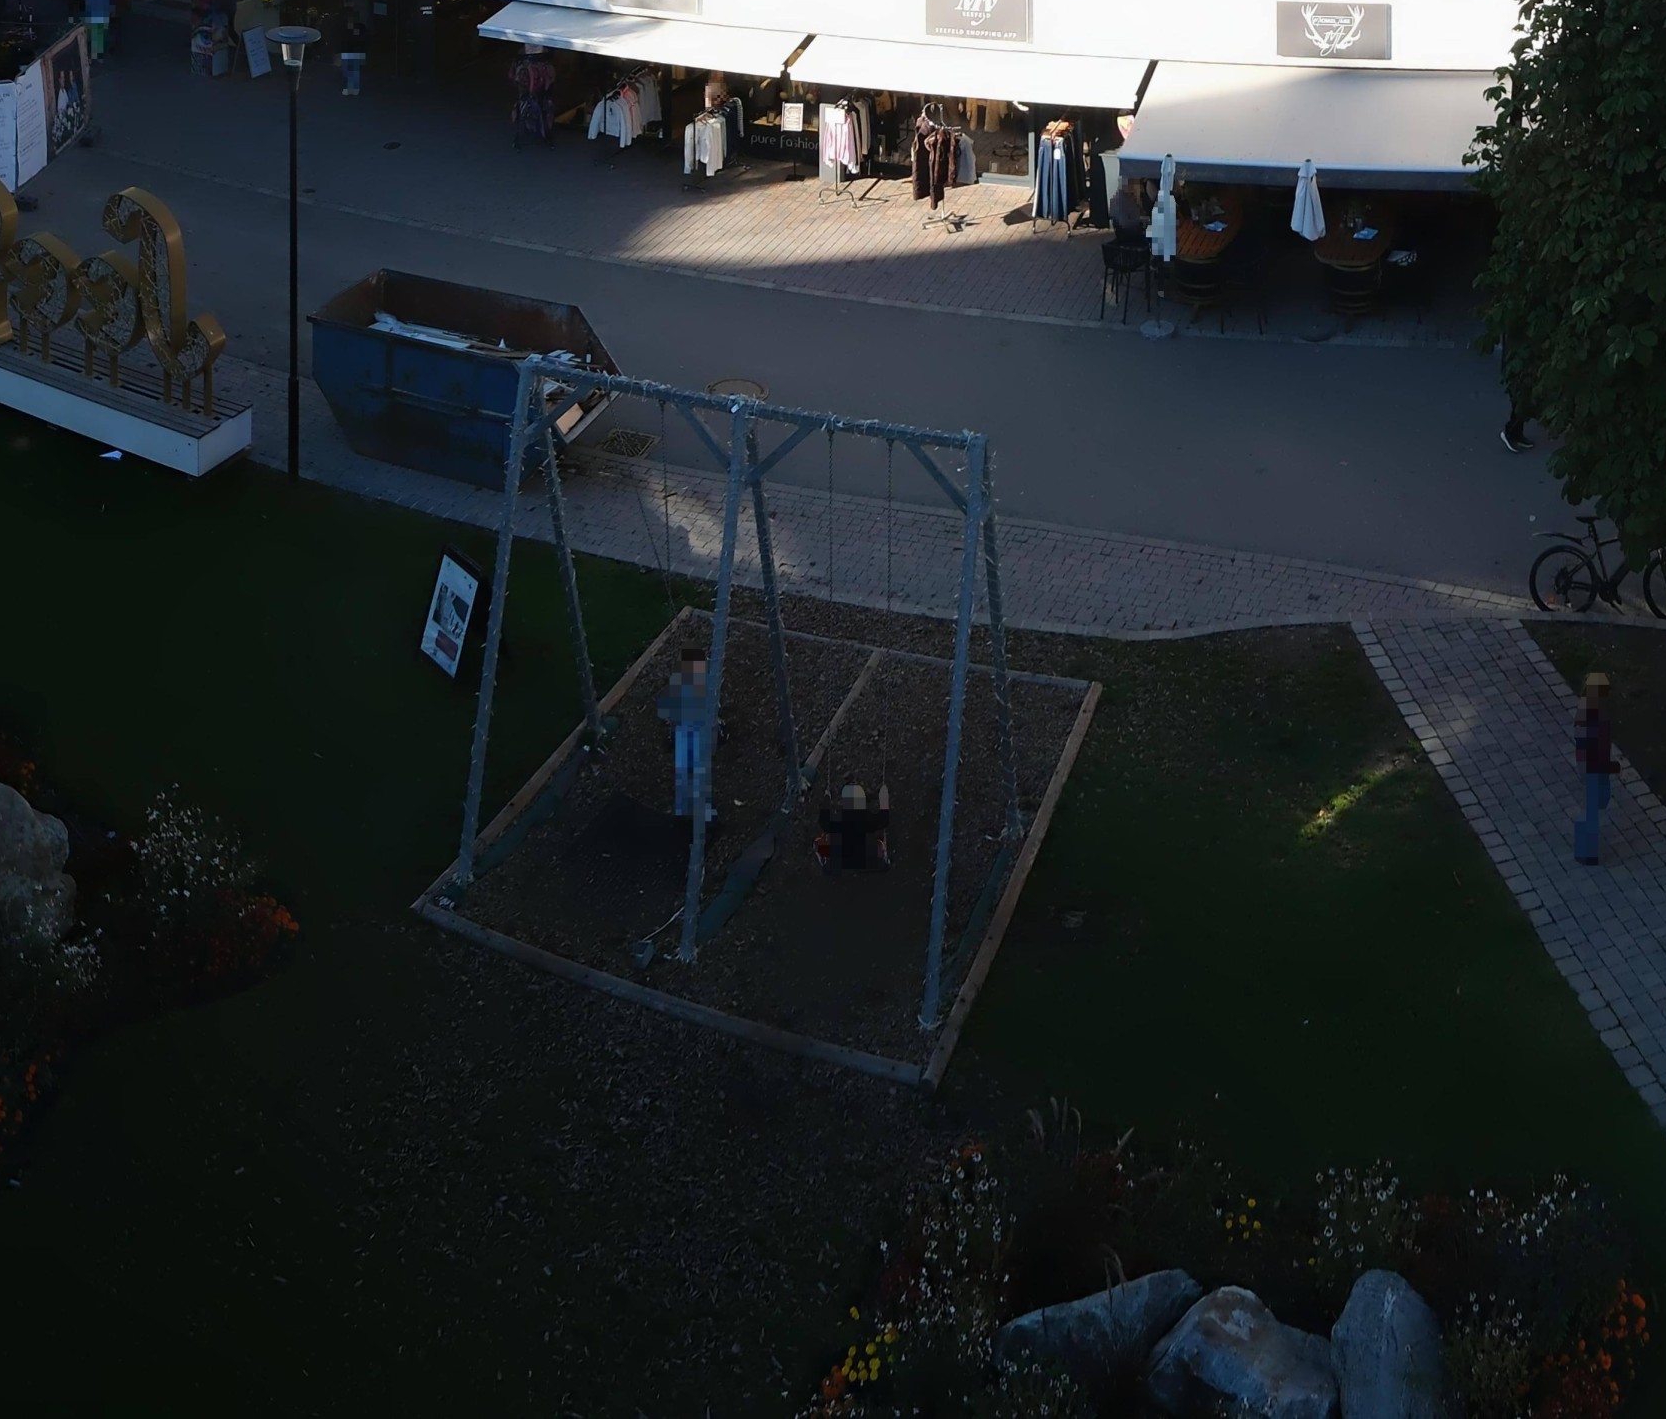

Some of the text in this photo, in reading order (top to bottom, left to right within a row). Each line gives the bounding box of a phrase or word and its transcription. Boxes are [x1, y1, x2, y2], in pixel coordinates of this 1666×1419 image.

[935, 27, 965, 35] SEEFELD
[966, 29, 1002, 38] SHOPPING
[750, 134, 777, 146] pure
